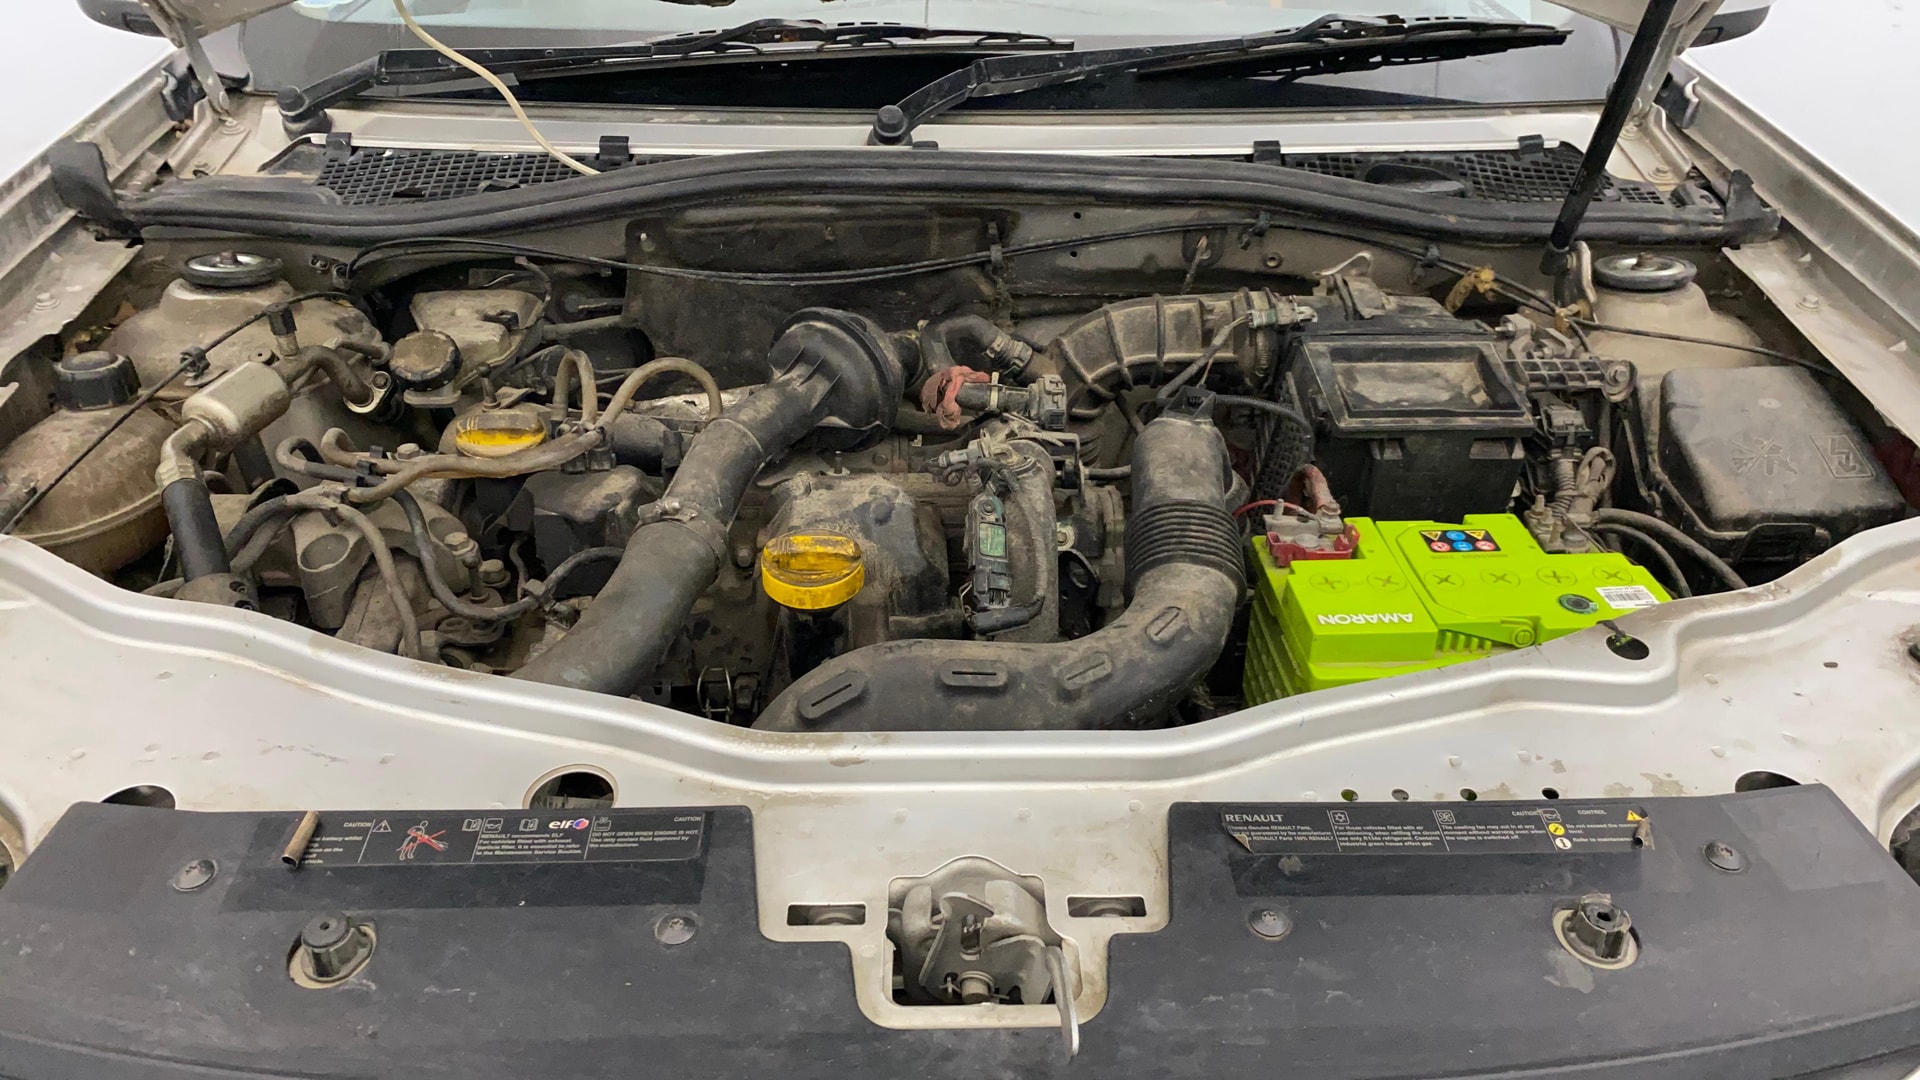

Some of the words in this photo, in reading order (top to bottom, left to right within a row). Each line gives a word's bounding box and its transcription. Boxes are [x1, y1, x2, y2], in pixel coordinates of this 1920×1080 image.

[1317, 613, 1412, 624] AMARON
[1225, 814, 1283, 822] RENAULT
[549, 820, 574, 829] elf
